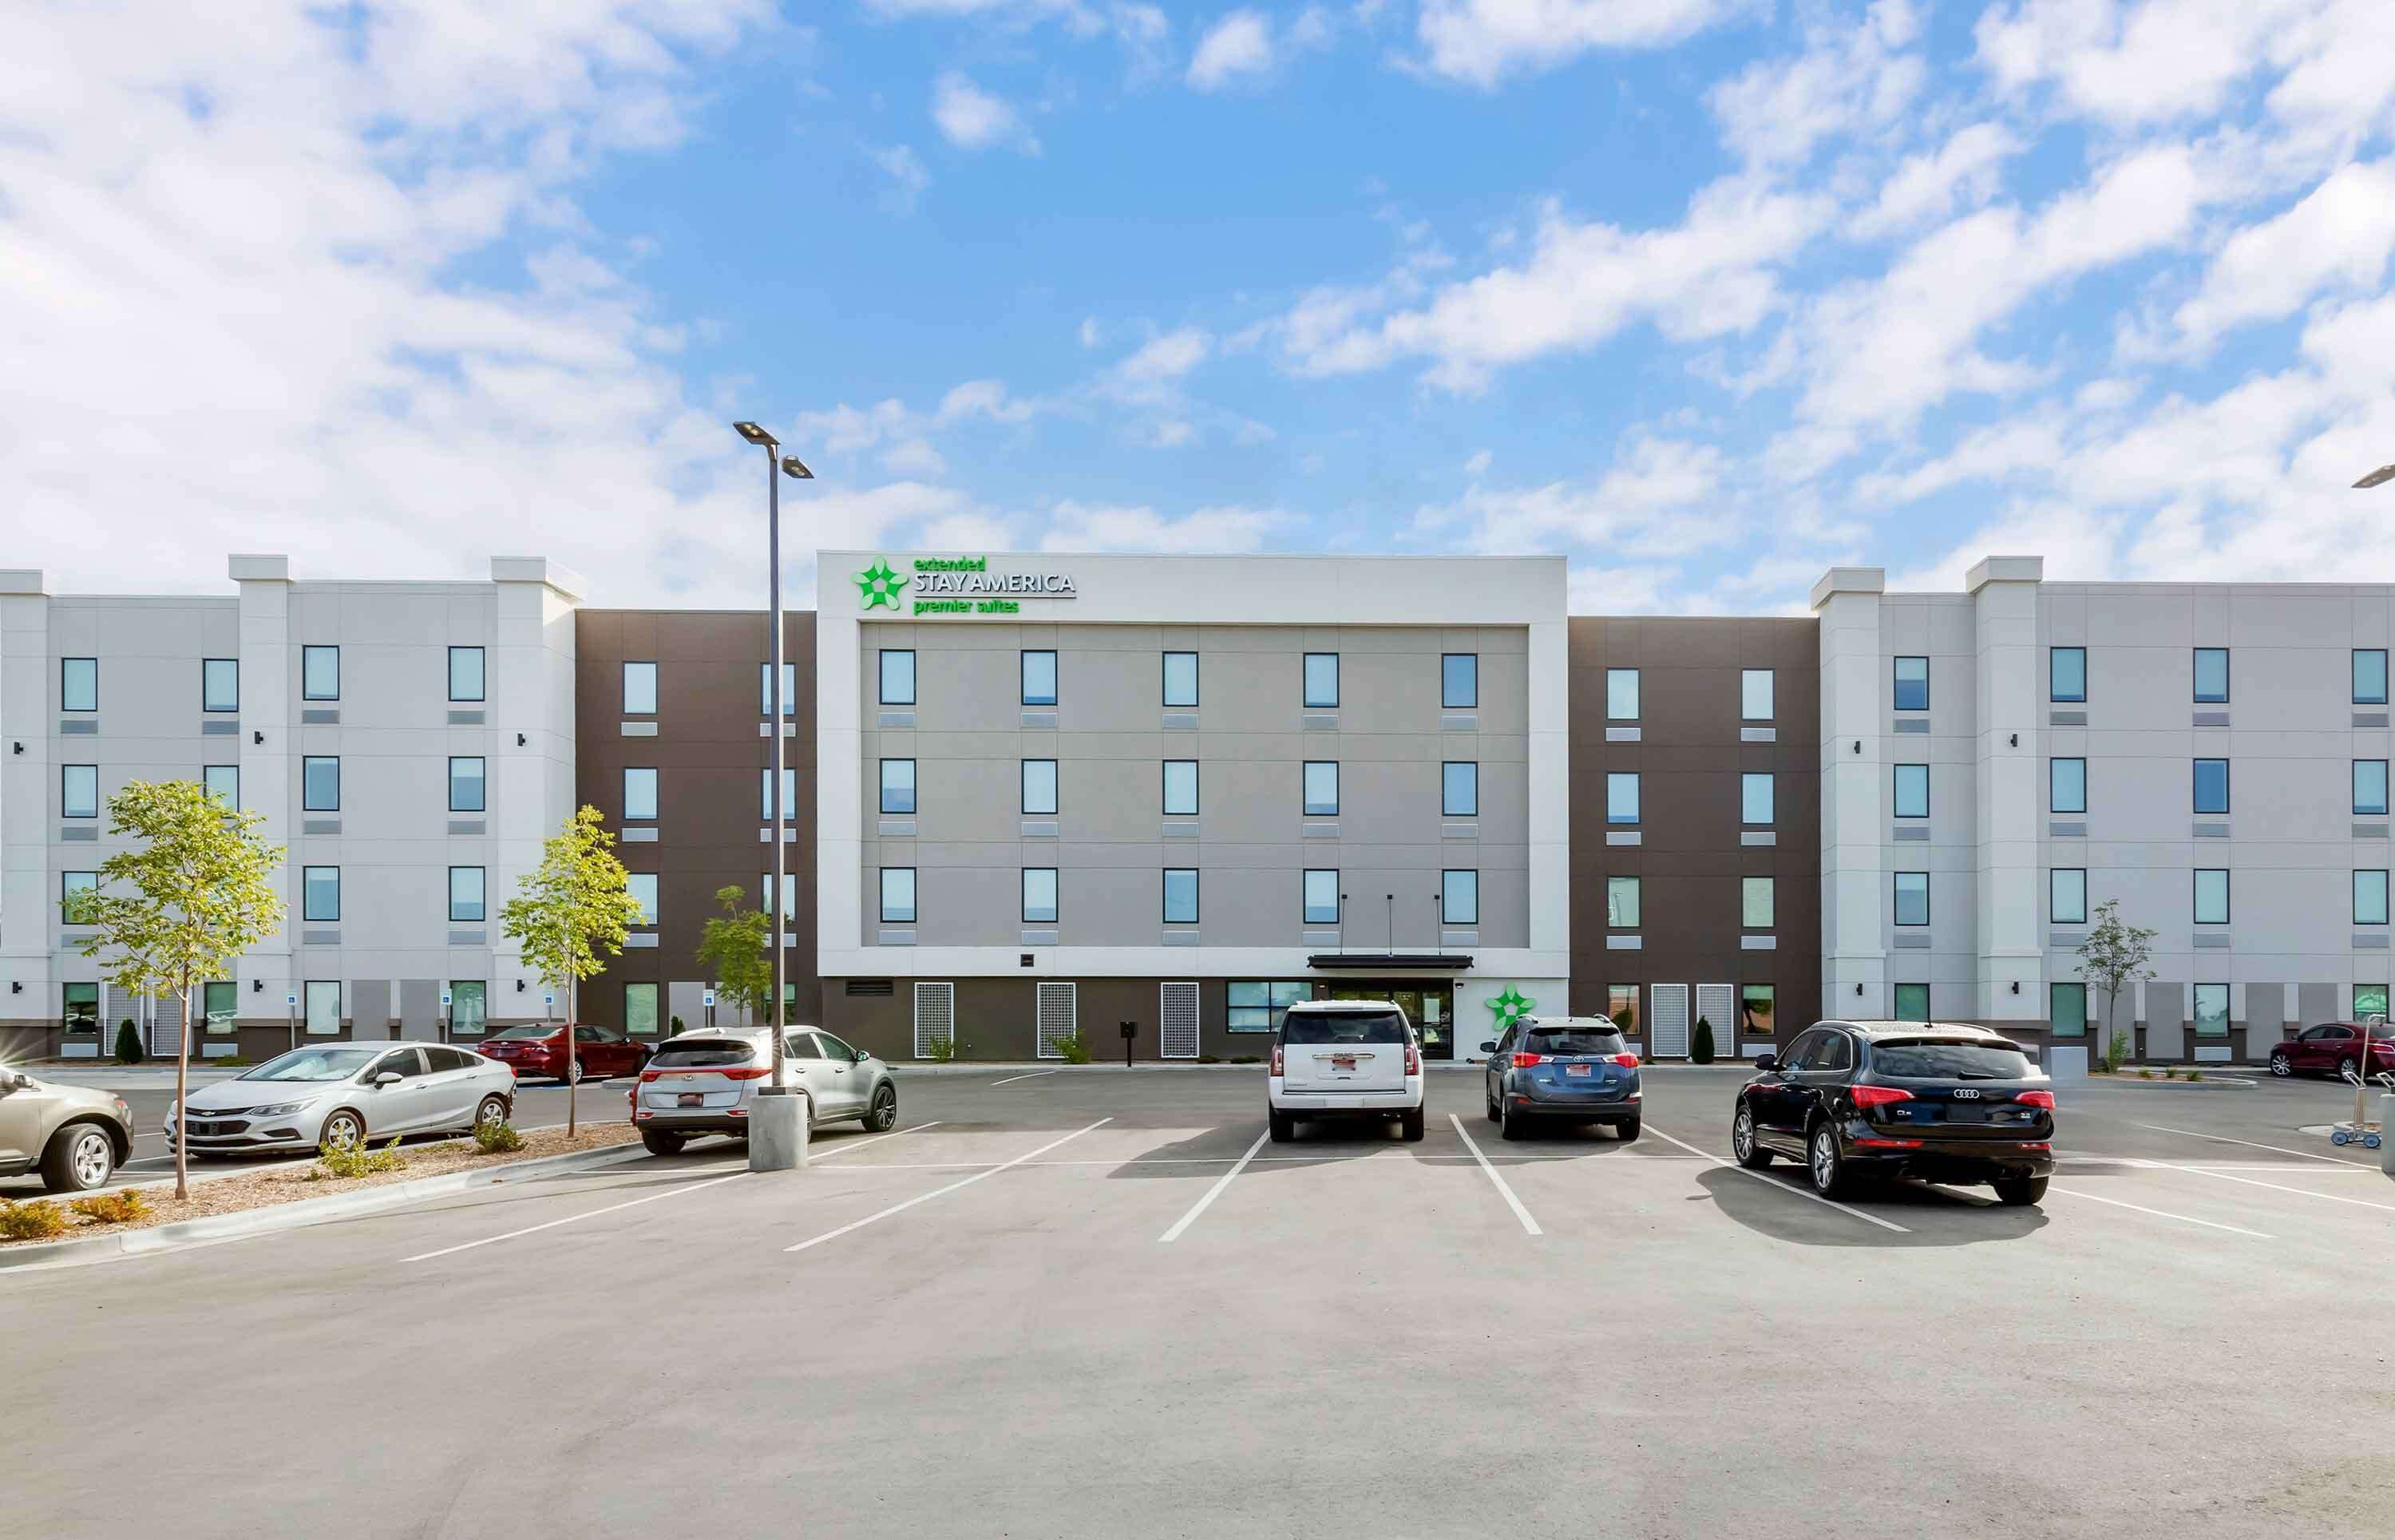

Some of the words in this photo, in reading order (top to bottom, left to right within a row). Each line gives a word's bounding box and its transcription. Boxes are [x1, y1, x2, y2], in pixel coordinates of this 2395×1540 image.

[913, 556, 986, 572] extended
[914, 573, 968, 592] STAY
[970, 573, 1075, 592] AMERICA
[913, 600, 972, 616] premier
[976, 600, 1019, 613] suites
